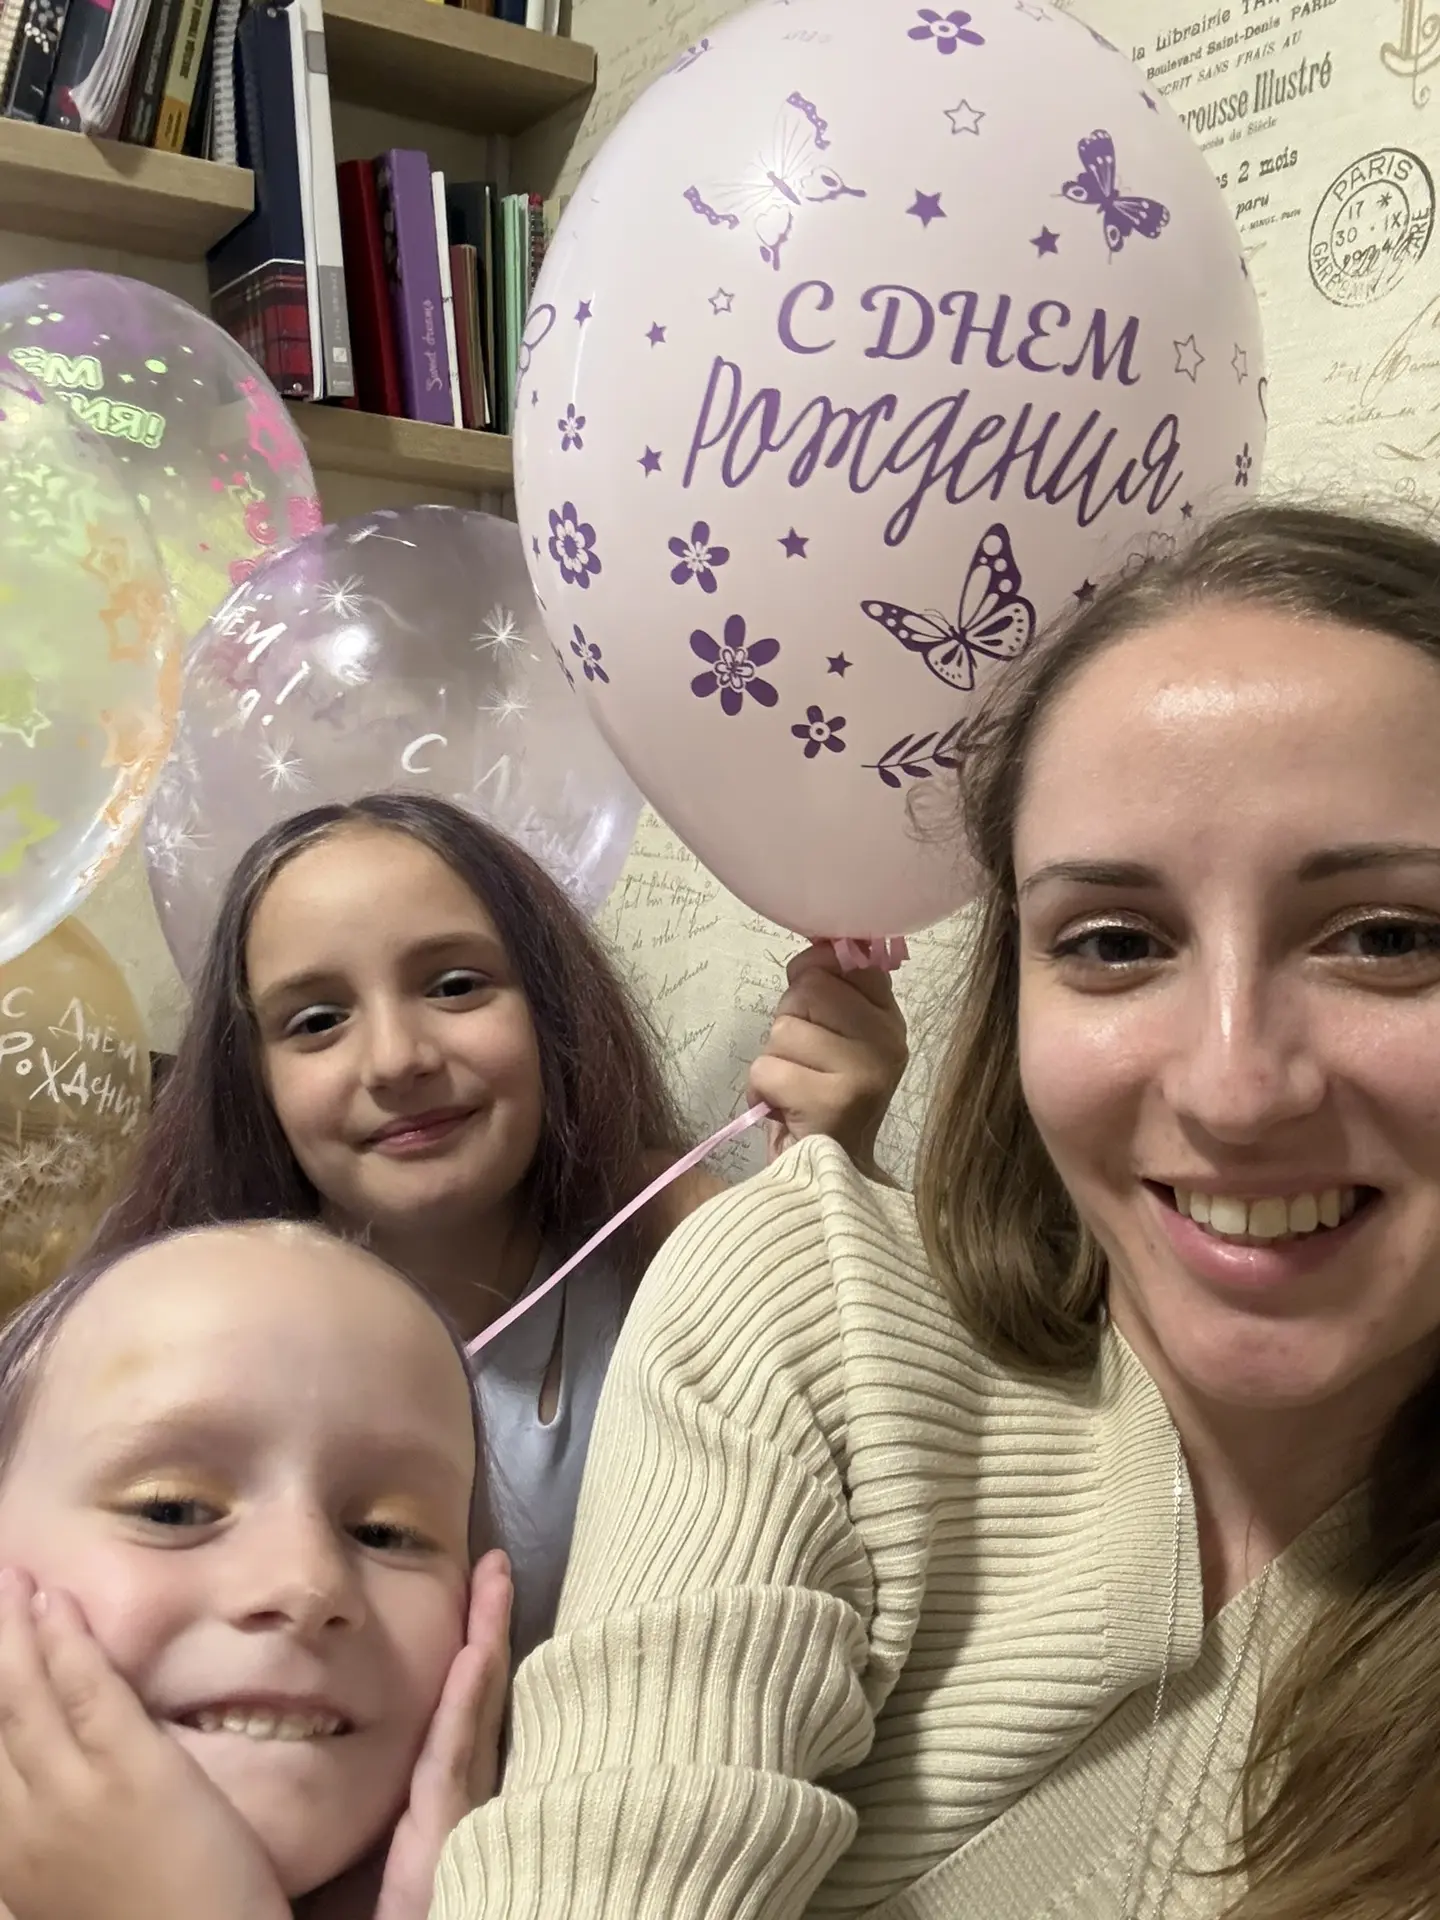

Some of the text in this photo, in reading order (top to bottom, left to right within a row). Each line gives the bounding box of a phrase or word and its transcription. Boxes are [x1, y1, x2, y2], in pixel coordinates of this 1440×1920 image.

[1131, 46, 1145, 62] la
[1155, 9, 1231, 52] Librairie
[1146, 46, 1203, 80] Boulevard
[1206, 16, 1281, 56] Saint-Denis
[1198, 60, 1230, 82] SANS
[1235, 41, 1276, 68] FRAIS
[1282, 30, 1303, 50] AU
[1252, 51, 1334, 114] Illustré
[1237, 160, 1250, 184] 2
[1258, 146, 1299, 177] mois
[1333, 155, 1414, 202] PARIS
[1235, 193, 1270, 220] paru
[1335, 211, 1403, 247] 30 IX
[1349, 200, 1365, 221] 17
[421, 298, 443, 392] Sweet dreams
[777, 280, 1141, 386] С ДНЕМ
